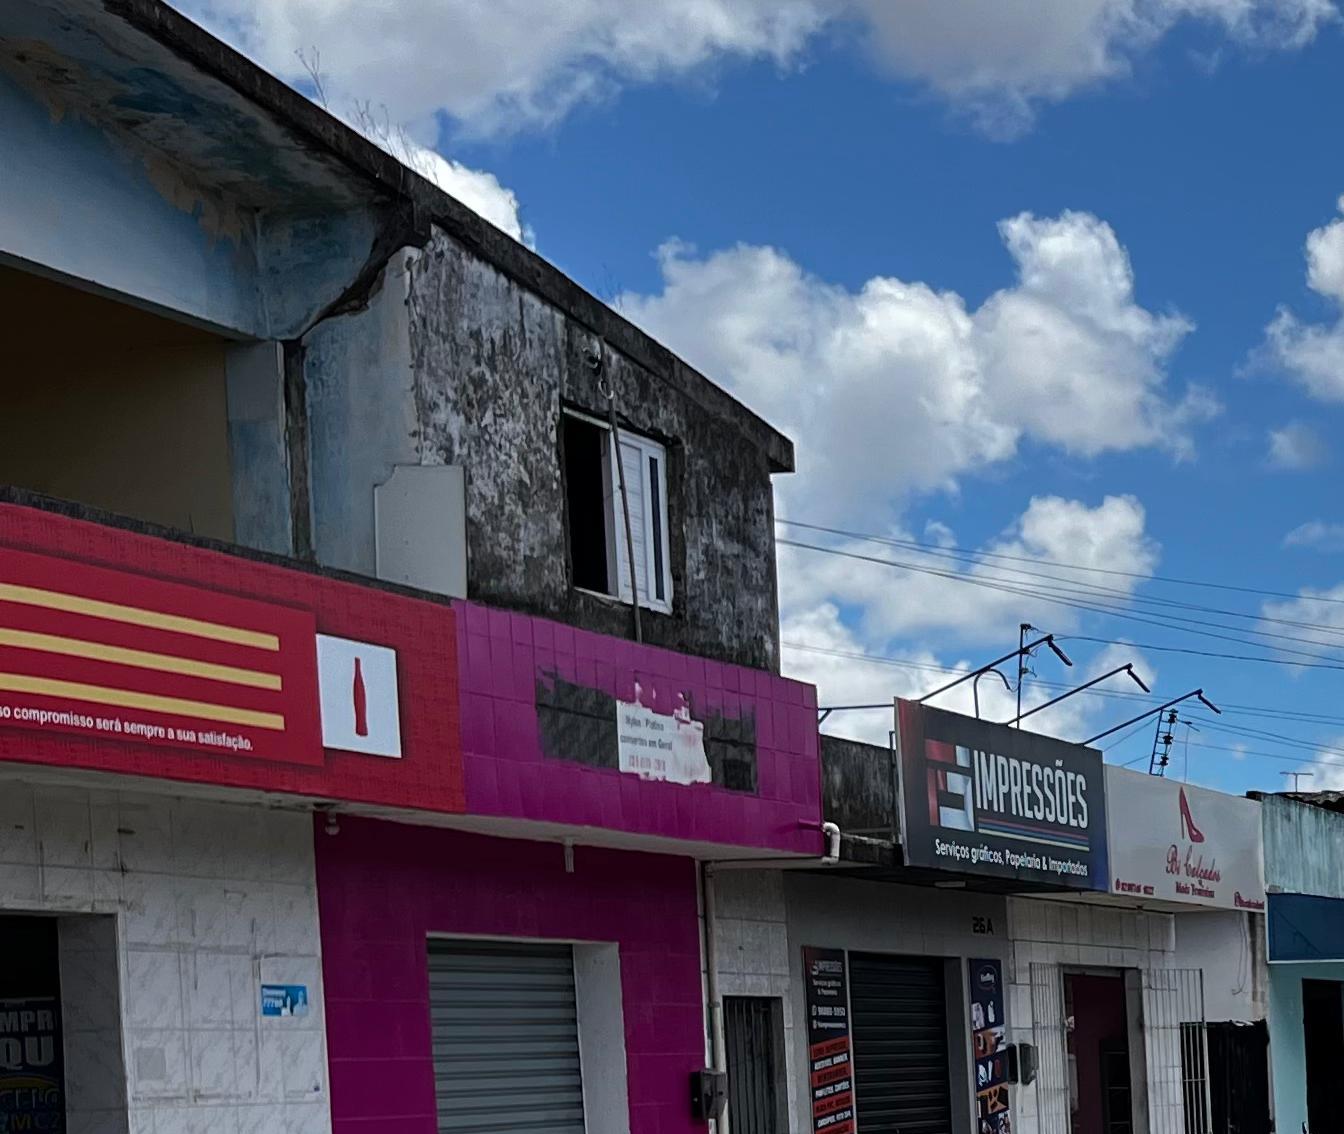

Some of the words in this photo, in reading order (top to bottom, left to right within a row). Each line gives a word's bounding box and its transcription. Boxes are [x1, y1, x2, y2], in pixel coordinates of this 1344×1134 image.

[14, 708, 93, 727] compromisso
[96, 717, 122, 733] será
[124, 720, 165, 739] sempre
[167, 728, 174, 739] a
[176, 729, 196, 742] sua
[198, 731, 253, 751] satisfação.
[973, 750, 1088, 829] IMPRESSÕES
[935, 838, 970, 861] Serviços
[971, 844, 1005, 867] gráficos,
[1005, 850, 1041, 870] Papelaria
[1042, 856, 1048, 870] &
[1049, 857, 1088, 876] Importados
[972, 916, 994, 935] 26A
